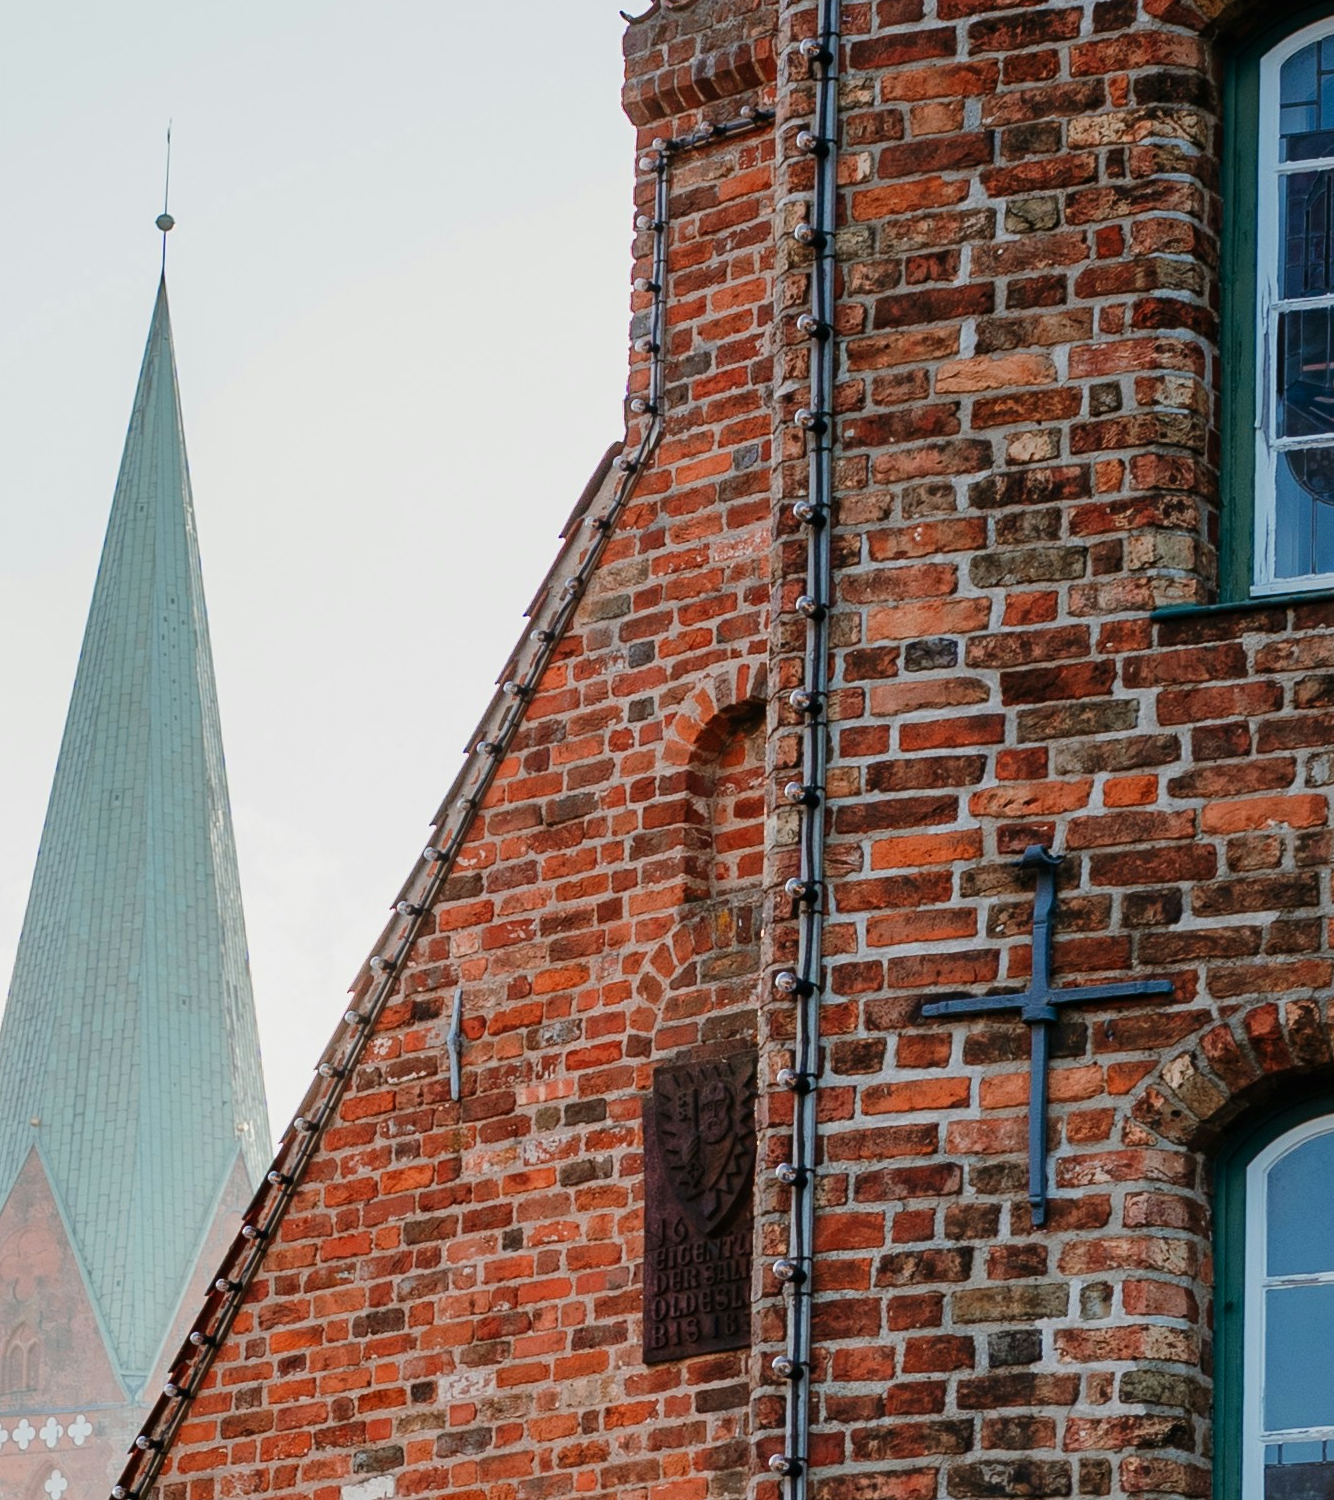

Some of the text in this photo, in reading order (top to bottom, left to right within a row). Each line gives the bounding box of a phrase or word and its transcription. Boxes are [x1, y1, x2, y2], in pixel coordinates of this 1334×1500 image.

[655, 1231, 753, 1271] EIGENTU
[652, 1257, 752, 1296] DER SALI
[652, 1317, 700, 1350] BIS
